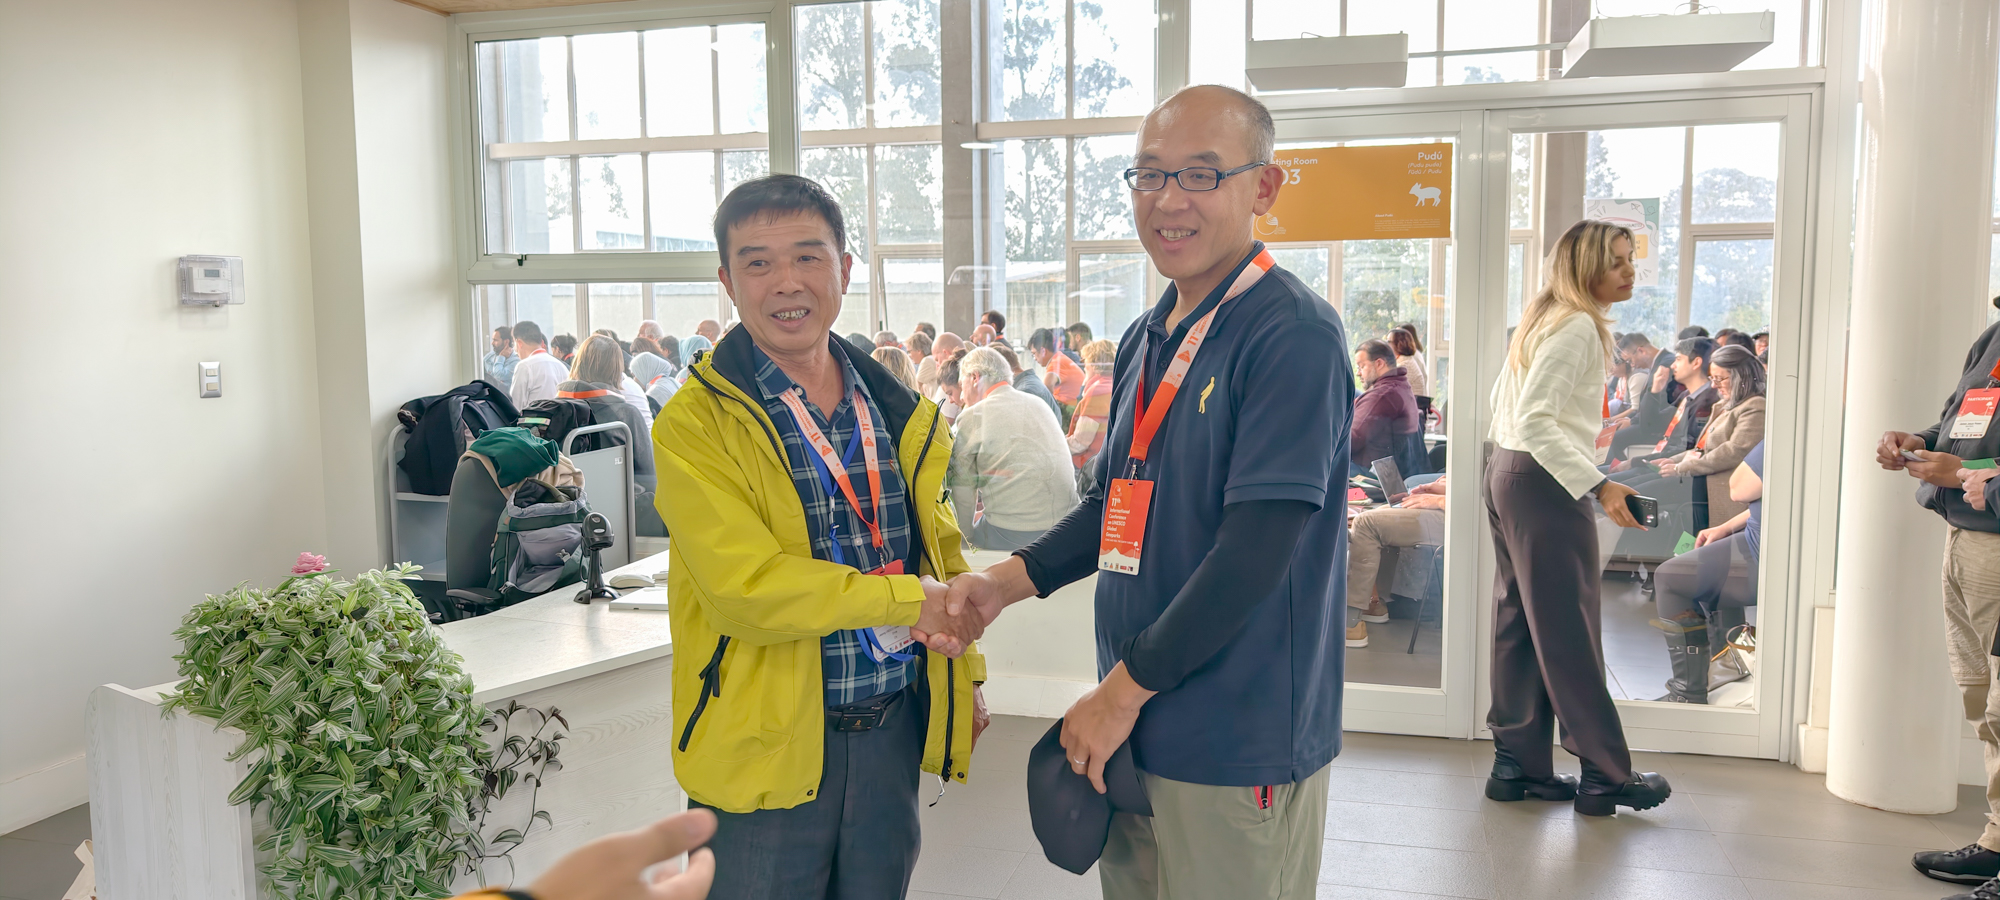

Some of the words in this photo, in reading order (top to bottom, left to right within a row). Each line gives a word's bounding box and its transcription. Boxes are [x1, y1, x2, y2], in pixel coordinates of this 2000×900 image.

[1417, 151, 1443, 160] Pudú
[1273, 158, 1292, 167] ting
[1293, 157, 1318, 165] Room
